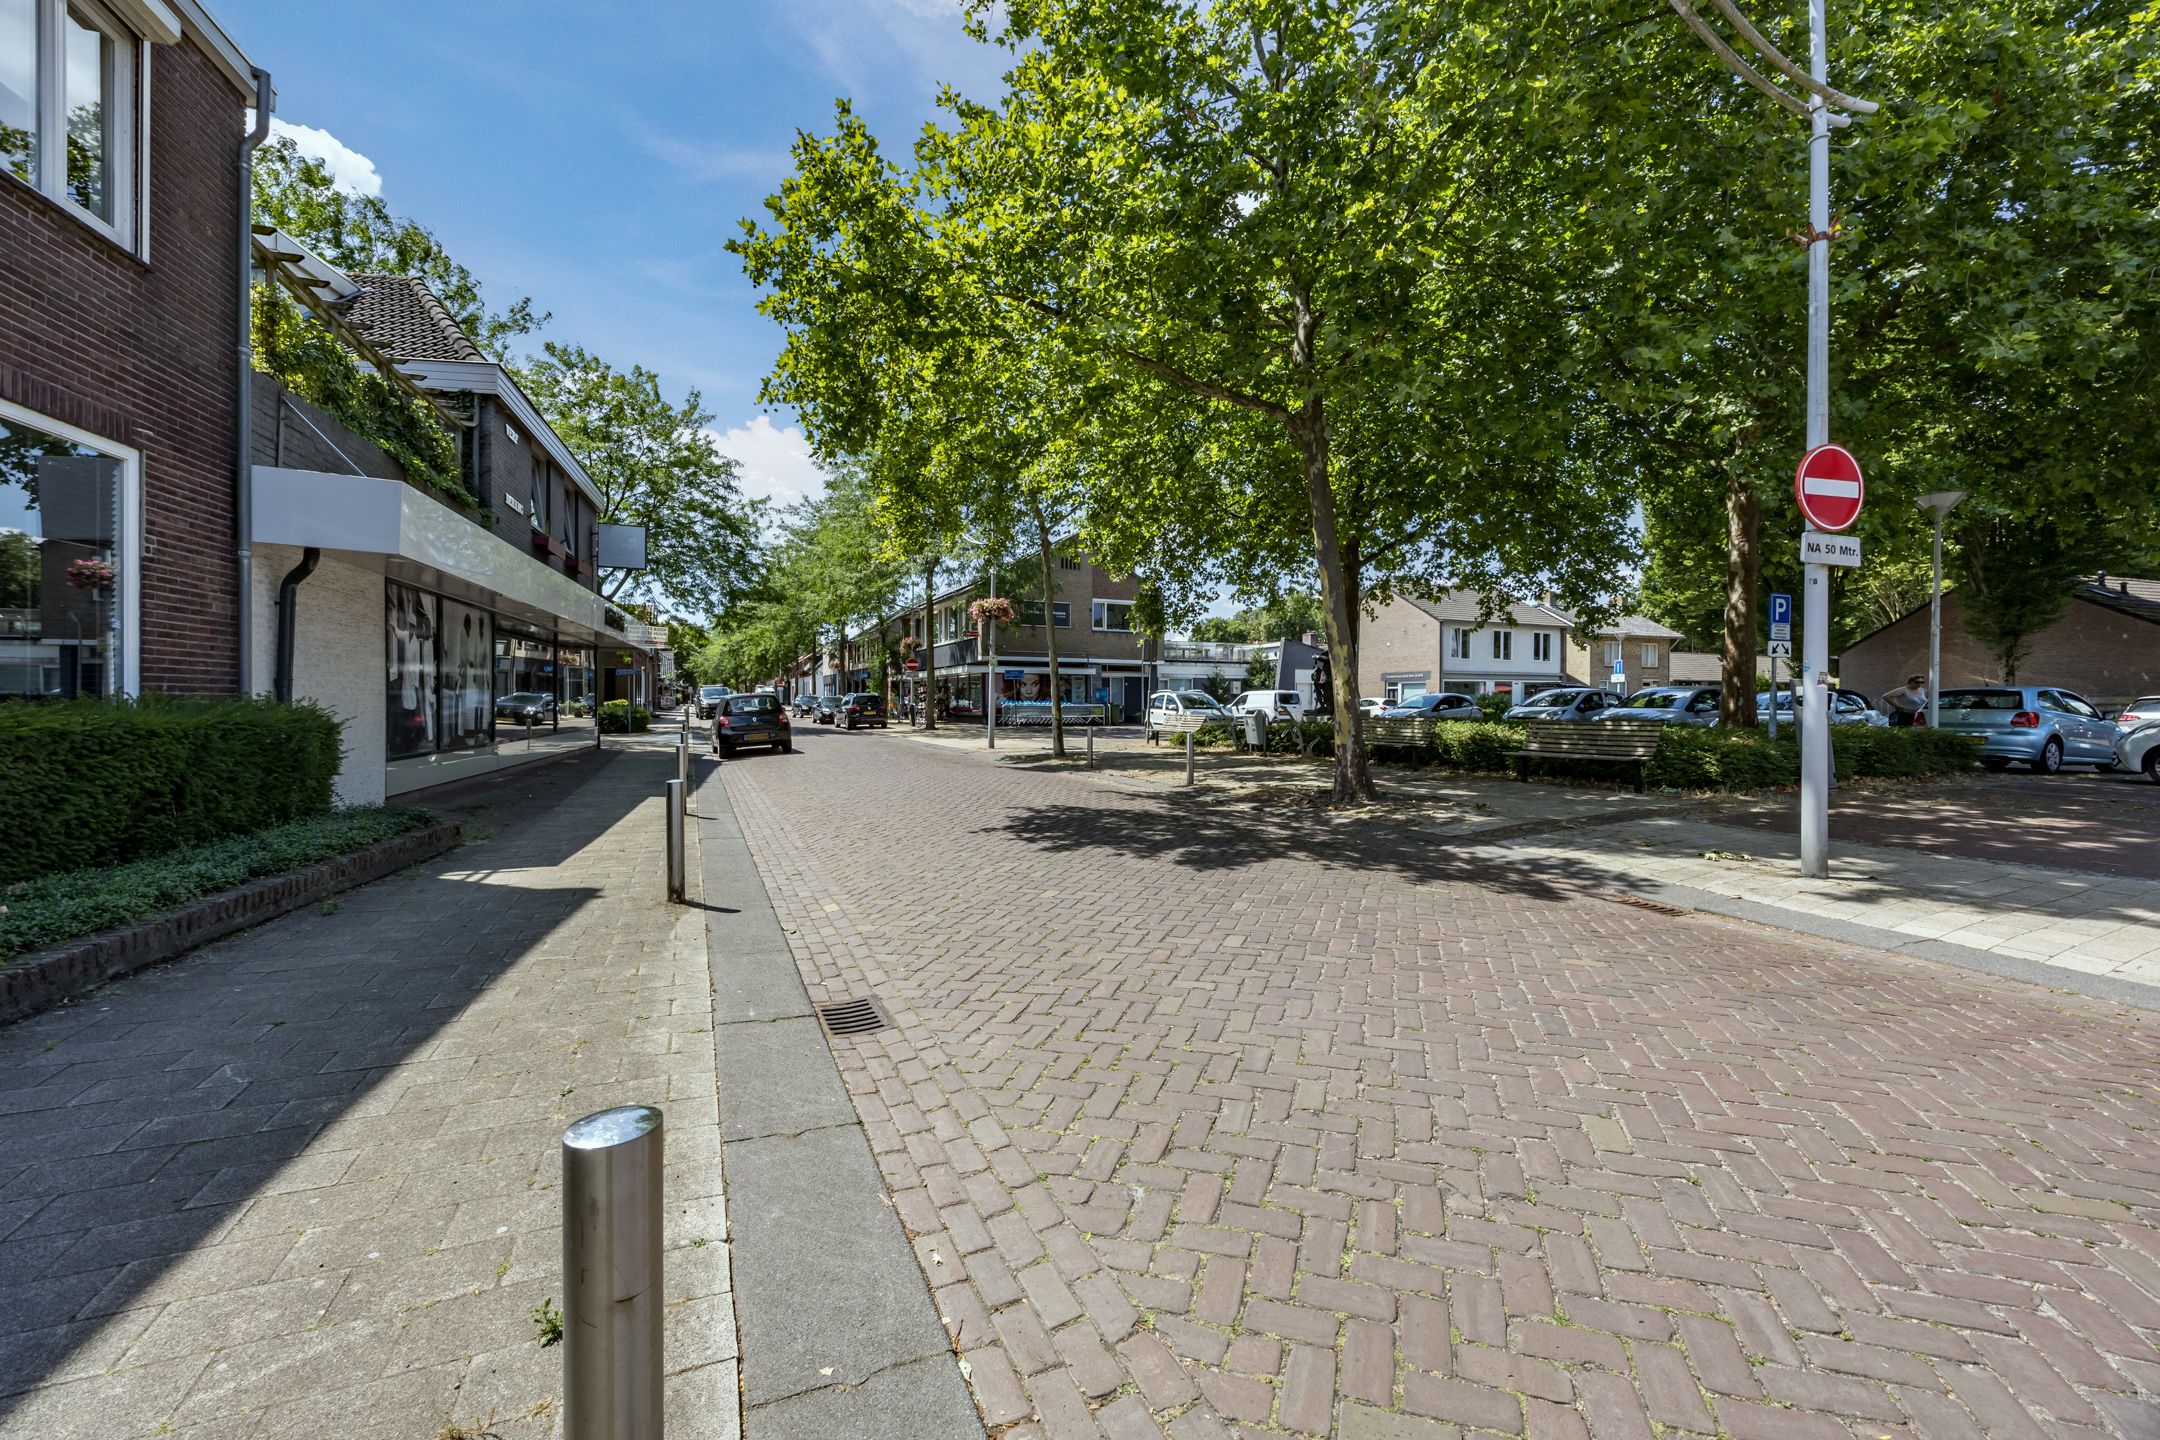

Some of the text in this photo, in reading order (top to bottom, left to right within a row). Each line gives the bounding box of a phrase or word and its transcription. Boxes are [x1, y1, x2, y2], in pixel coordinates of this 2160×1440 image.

[1807, 542, 1858, 556] NA 50 Mtr.
[1775, 598, 1787, 621] P
